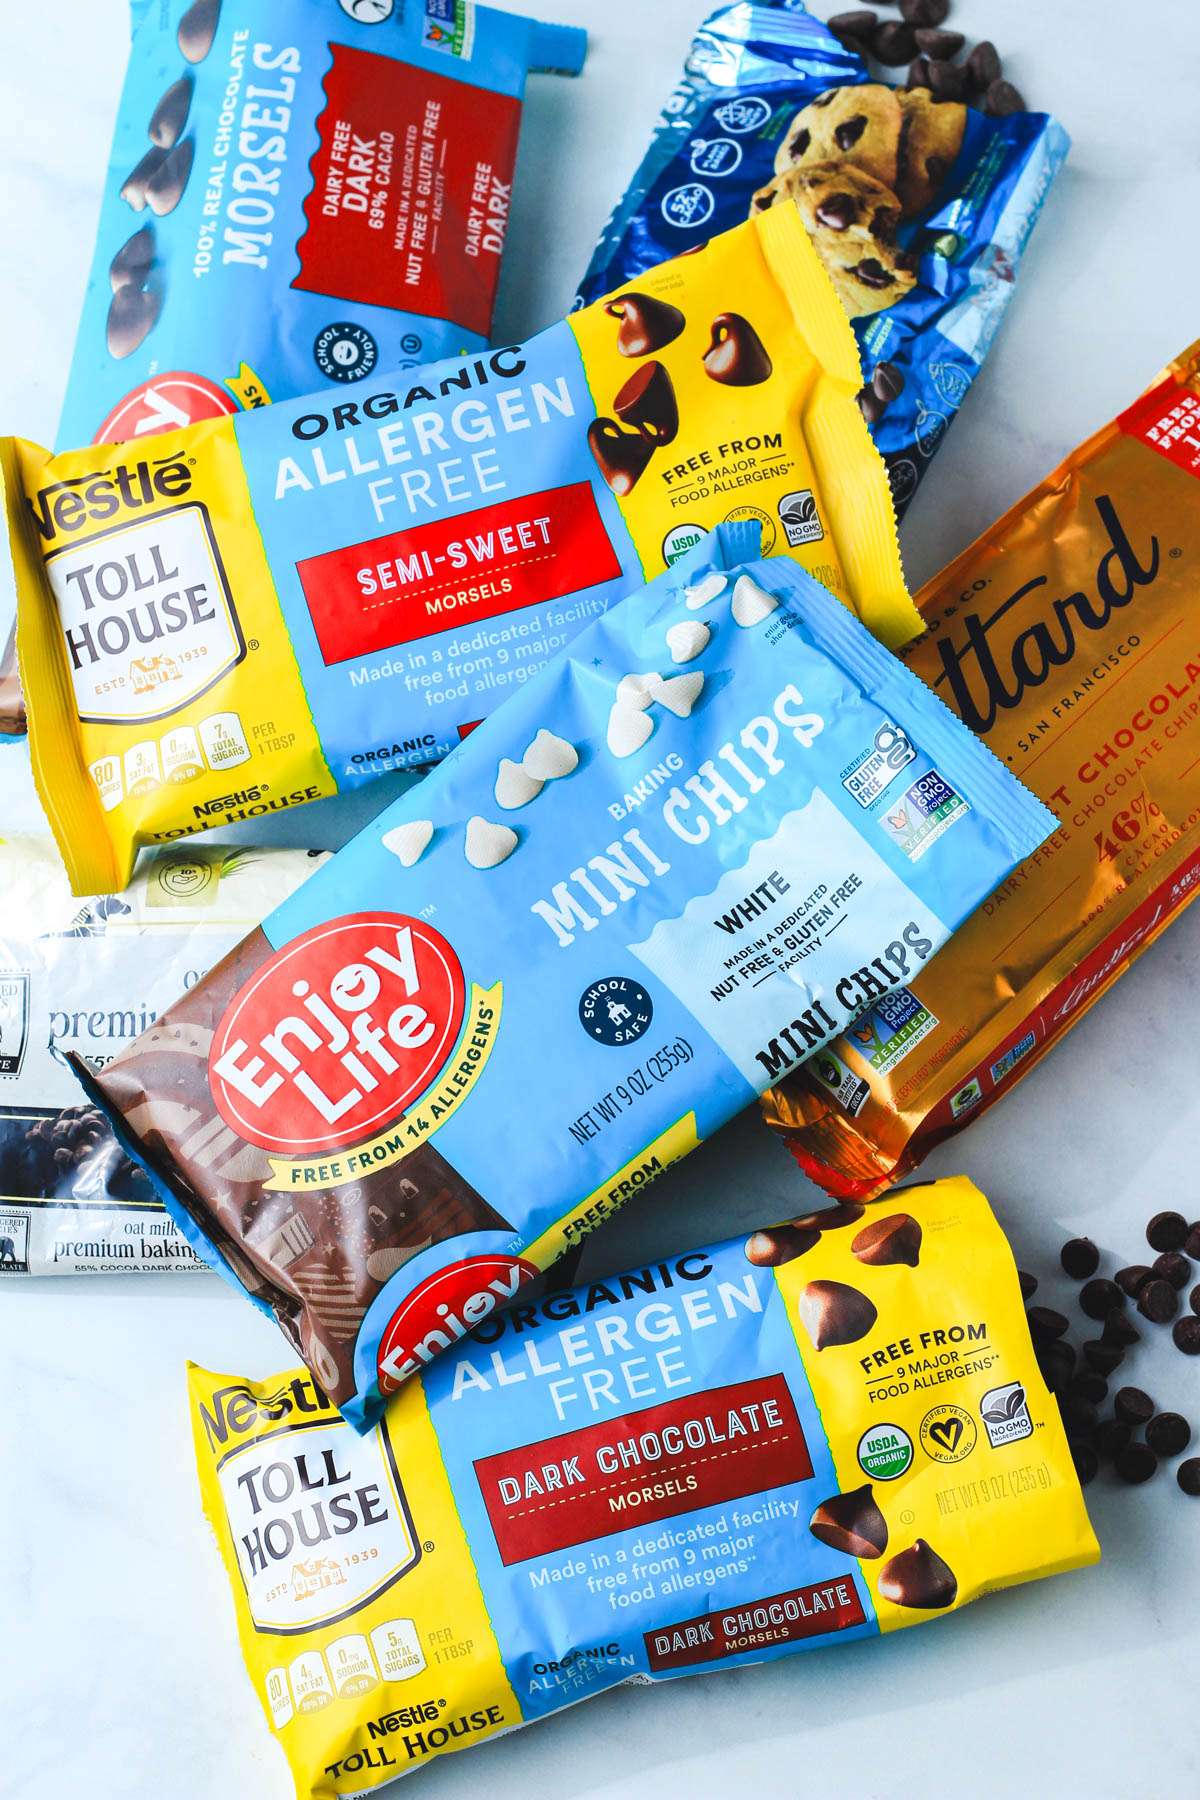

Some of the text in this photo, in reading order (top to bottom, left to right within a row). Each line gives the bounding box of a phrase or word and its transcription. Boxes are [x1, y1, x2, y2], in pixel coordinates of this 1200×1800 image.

[193, 29, 249, 278] 100% REAL CHOCOLATE
[222, 43, 301, 270] MORSELS
[322, 120, 351, 217] DAIRY FREE
[342, 134, 377, 213] DARK
[368, 131, 395, 230] 69% CACAO
[394, 125, 418, 250] MADE DEDICATED
[405, 100, 442, 286] NUT FREE GLUTEN FREE
[432, 172, 446, 221] FACILITY
[465, 162, 492, 257] DAIRY FREE
[482, 176, 511, 254] DARK
[317, 327, 340, 374] SCHOOL
[347, 329, 375, 380] FRIENDLY
[292, 345, 527, 441] ORGANIC
[275, 377, 576, 500] ALLERGEN
[1145, 396, 1198, 442] FREE
[661, 433, 783, 485] FREE FROM
[696, 457, 757, 485] 9 MAJOR
[367, 448, 506, 523] FREE
[670, 487, 710, 508] FOOD
[65, 544, 179, 611] TOLL
[356, 517, 551, 596] SEMI-SWEET
[424, 578, 513, 616] MORSELS
[934, 494, 1160, 735] ttard
[960, 577, 994, 603] CO.
[65, 583, 215, 670] HOUSE
[349, 598, 609, 687] Made in a dedicated facility
[177, 646, 208, 664] 1939
[403, 632, 568, 692] free from 9 major
[423, 684, 469, 706] food
[1017, 634, 1142, 753] SAN FRANCISCO
[211, 737, 239, 753] TOTAL
[211, 746, 246, 764] SUGARS
[252, 721, 277, 739] PER
[266, 733, 296, 753] TBSP
[350, 734, 436, 764] ORGANIC
[343, 743, 450, 776] ALLERGEN
[839, 748, 871, 778] CERTIFIED
[848, 754, 885, 792] GLUTEN
[193, 785, 262, 819] Nestlé
[607, 752, 684, 821] BAKING
[857, 776, 883, 804] FREE
[911, 775, 938, 801] NON
[917, 784, 945, 807] GMO
[923, 790, 951, 815] Project
[152, 786, 322, 839] TOLL HOUSE
[530, 684, 825, 948] MINI CHIPS
[906, 799, 960, 850] VERIFIED
[981, 829, 1071, 917] DAIRY-FREE
[1072, 738, 1163, 827] CHOCOLATE
[1093, 790, 1161, 865] 46%
[1125, 823, 1169, 866] CACAO
[713, 870, 791, 935] WHITE
[723, 884, 828, 971] MADE DEDICATED
[710, 873, 863, 1002] NUT FREE GLUTEN FREE
[778, 937, 823, 972] FACILITY
[212, 926, 420, 1108] Enjoy
[584, 980, 628, 1018] SCHOOL
[755, 921, 933, 1080] MINI CHIPS
[884, 995, 912, 1022] GMO
[892, 1003, 918, 1029] Project
[615, 1013, 648, 1041] SAFE
[873, 1011, 928, 1065] VERIFIED
[292, 1004, 436, 1124] Life
[568, 1036, 694, 1146] NET WT 9 OZ (255g)
[291, 1163, 342, 1183] FREE
[348, 1135, 405, 1173] FROM
[406, 1118, 430, 1138] 14
[562, 1156, 662, 1240] FREE FROM
[53, 1239, 134, 1262] premium
[124, 1221, 145, 1235] oat
[100, 1264, 173, 1272] COCOA DARK
[470, 1253, 713, 1345] ORGANIC
[452, 1274, 763, 1401] ALLERGEN
[859, 1323, 987, 1375] FREE FROM
[549, 1346, 692, 1421] FREE
[896, 1351, 959, 1378] 9 MAJOR
[868, 1382, 910, 1404] FOOD
[867, 1434, 899, 1453] USDA
[922, 1407, 971, 1440] CERTIFIED VEGAN
[497, 1399, 784, 1506] DARK CHOCOLATE
[867, 1451, 906, 1469] ORGANIC
[237, 1449, 352, 1514] TOLL
[608, 1475, 698, 1513] MORSELS
[935, 1475, 1010, 1516] NET WT 9 OZ
[241, 1483, 389, 1577] HOUSE
[528, 1499, 801, 1590] Made in a dedicated facility
[344, 1548, 379, 1567] 1939
[586, 1533, 756, 1596] free from 9 major
[608, 1587, 656, 1612] food
[654, 1584, 851, 1655] DARK CHOCOLATE
[386, 1645, 413, 1661] TOTAL
[428, 1627, 453, 1646] PER
[443, 1640, 474, 1662] TBSP
[533, 1643, 620, 1675] ORGANIC
[725, 1627, 790, 1651] MORSELS
[385, 1654, 420, 1674] SUGARS
[324, 1705, 505, 1779] TOLL HOUSE
[366, 1700, 439, 1739] Nestlé
